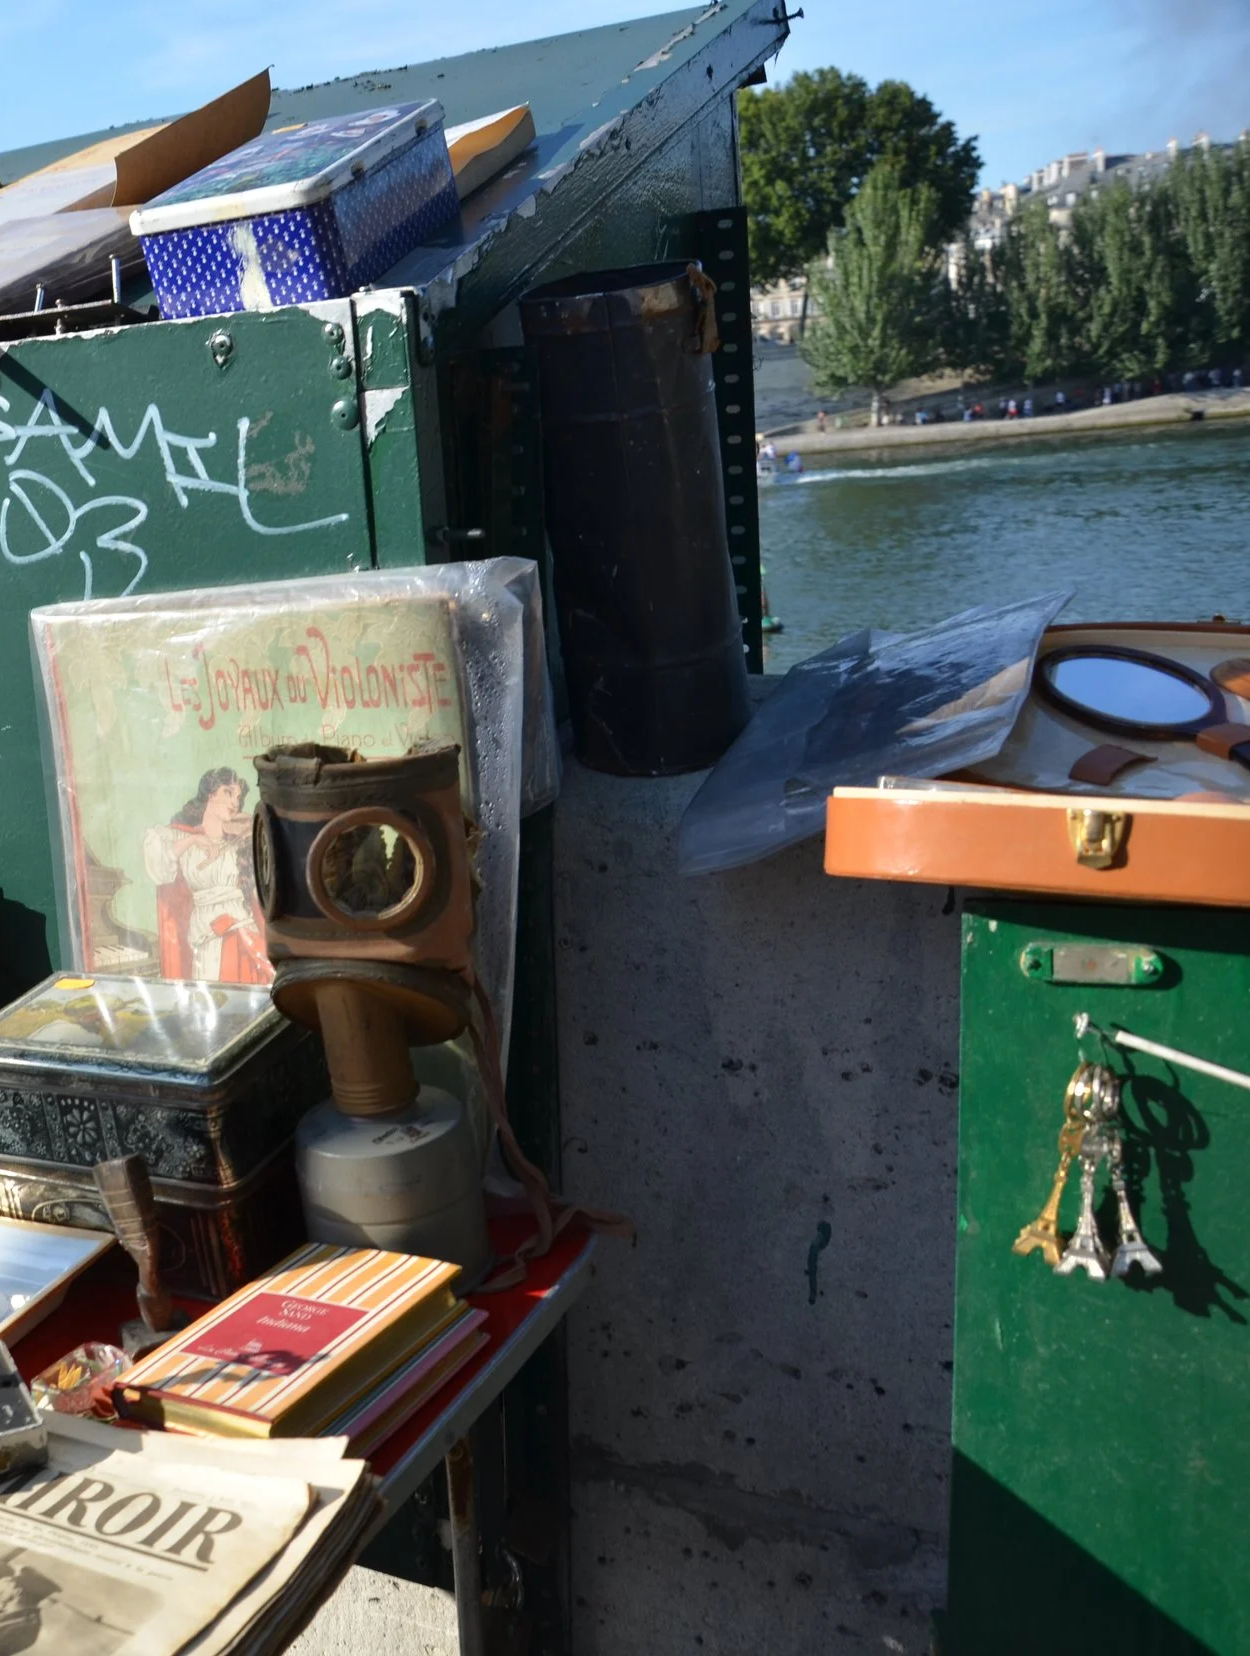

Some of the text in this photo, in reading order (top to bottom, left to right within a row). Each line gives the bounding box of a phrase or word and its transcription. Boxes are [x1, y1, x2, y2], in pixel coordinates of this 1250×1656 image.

[192, 641, 284, 731] JOYAUX
[322, 724, 376, 747] Piano
[279, 1309, 312, 1320] SAND
[281, 1300, 329, 1316] GEORGE
[256, 1316, 310, 1333] Indiana
